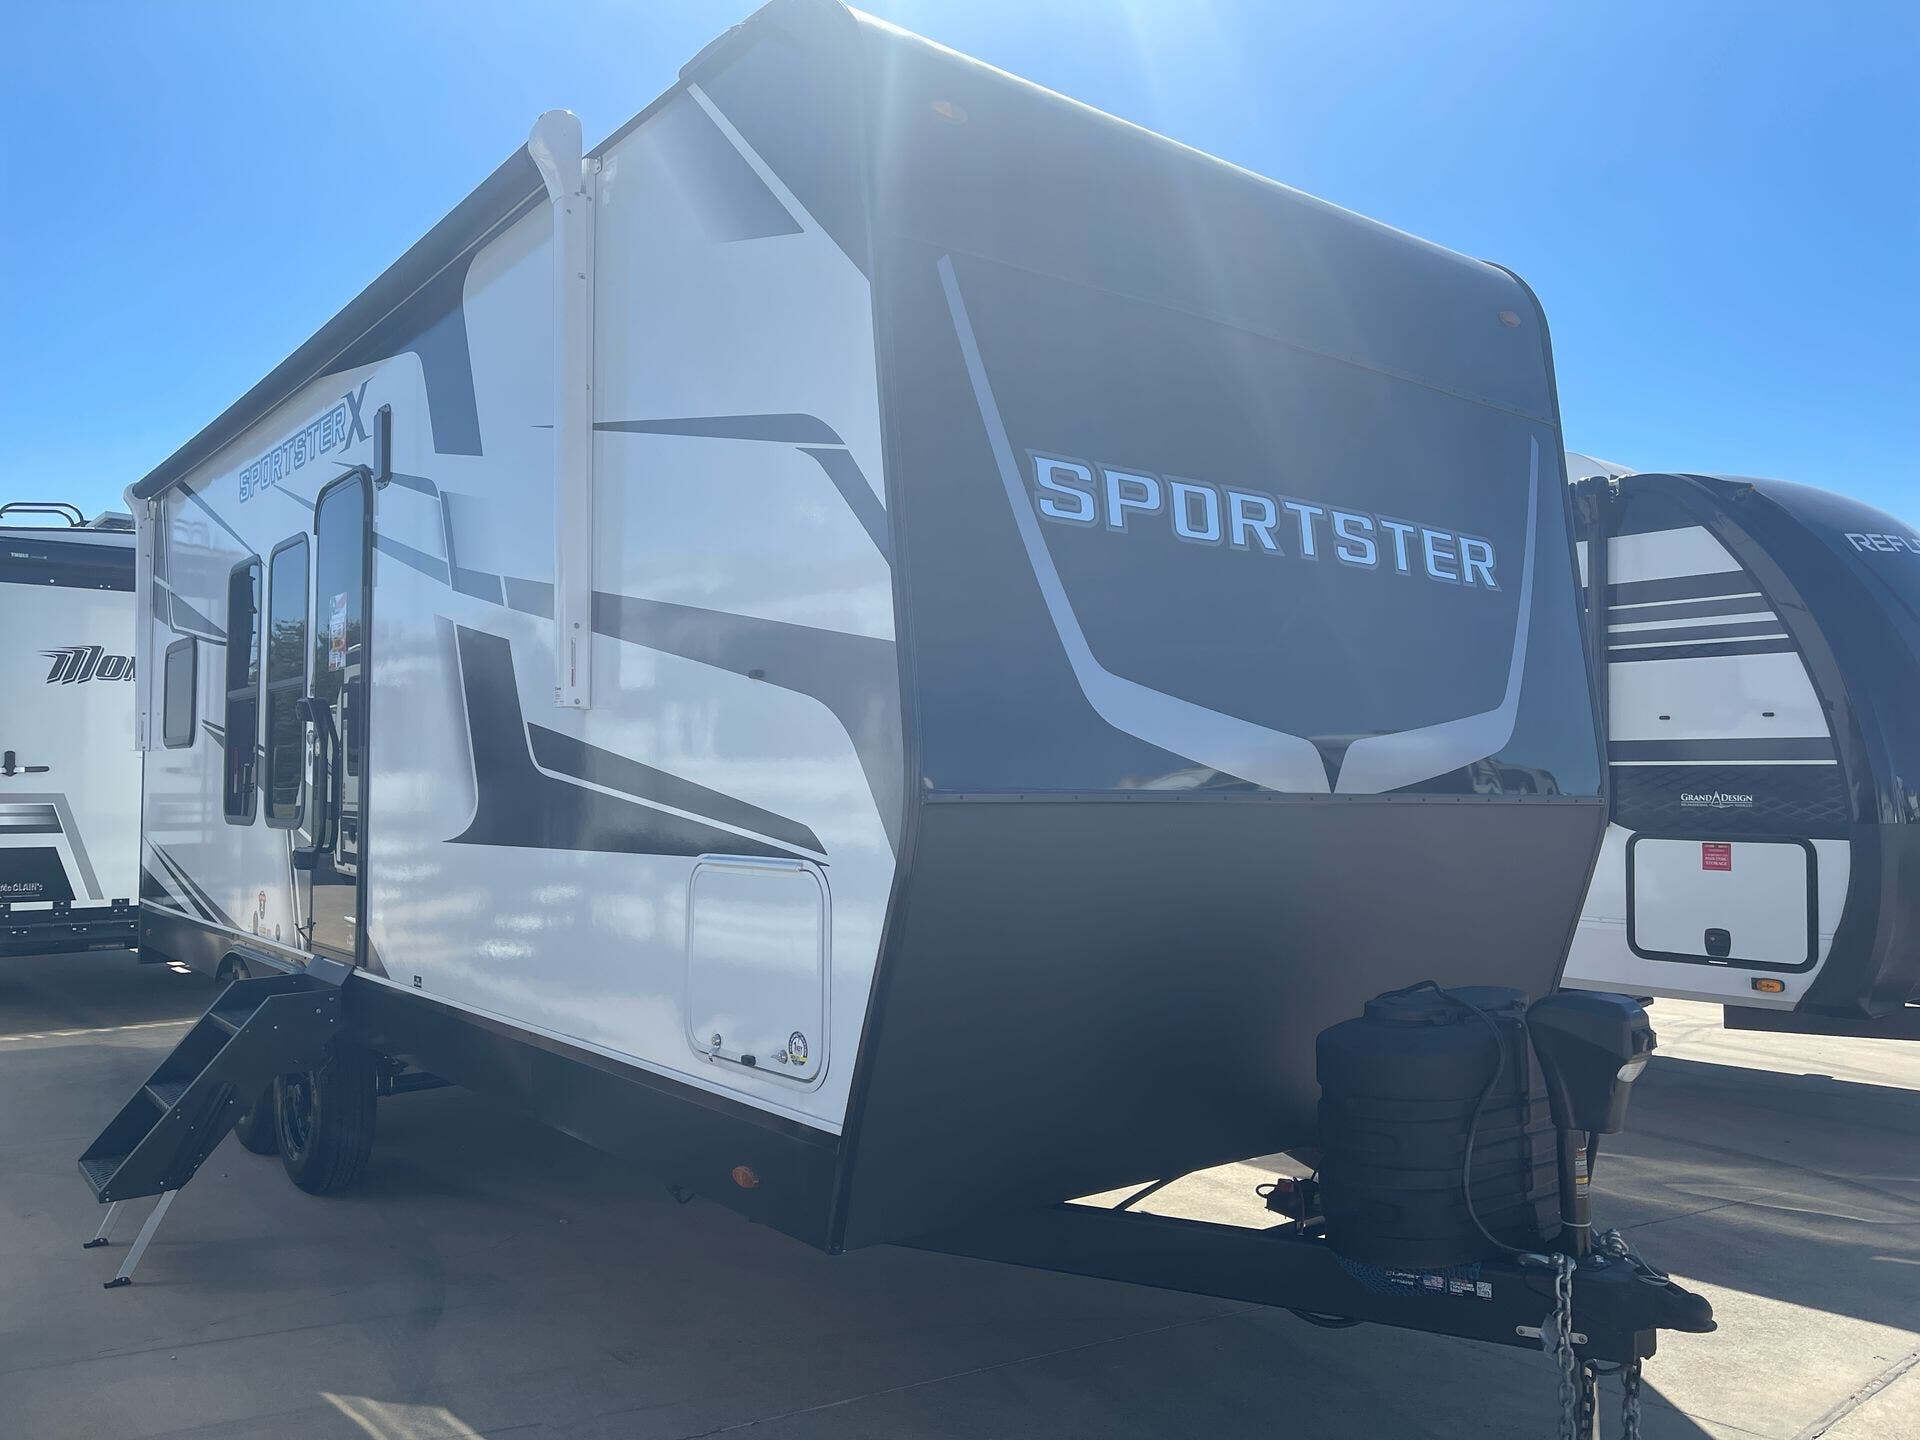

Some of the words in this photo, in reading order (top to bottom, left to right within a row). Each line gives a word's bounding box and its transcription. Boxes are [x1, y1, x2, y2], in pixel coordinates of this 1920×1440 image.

[1026, 449, 1501, 591] SPORTSTER
[1844, 533, 1920, 554] REFL
[1680, 793, 1713, 801] GRAND
[1721, 793, 1753, 802] DESIGN
